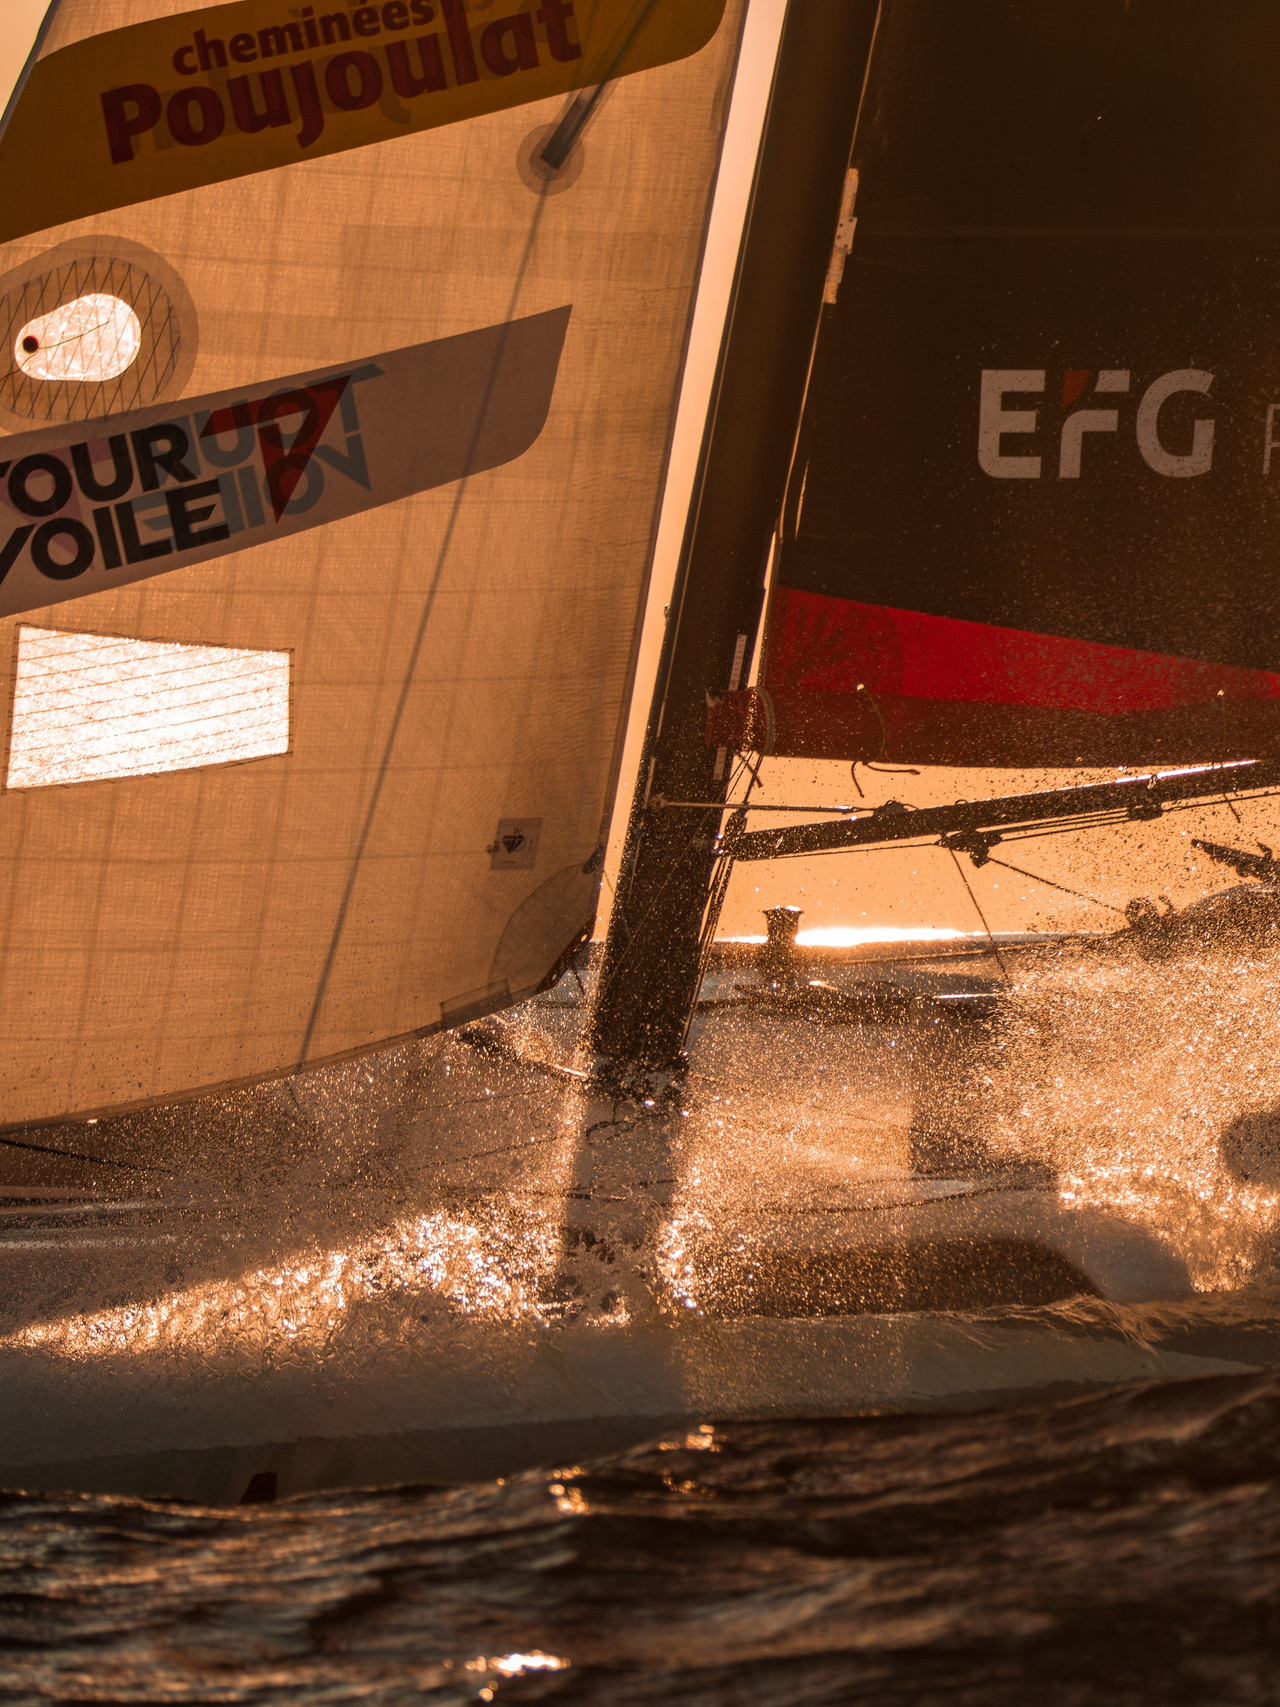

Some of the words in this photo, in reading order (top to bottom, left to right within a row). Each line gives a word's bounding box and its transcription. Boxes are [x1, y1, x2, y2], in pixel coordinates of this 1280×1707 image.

[100, 0, 583, 165] Poujoulat
[172, 0, 435, 76] cheminées
[0, 423, 197, 517] OUR
[976, 368, 1216, 479] EFG
